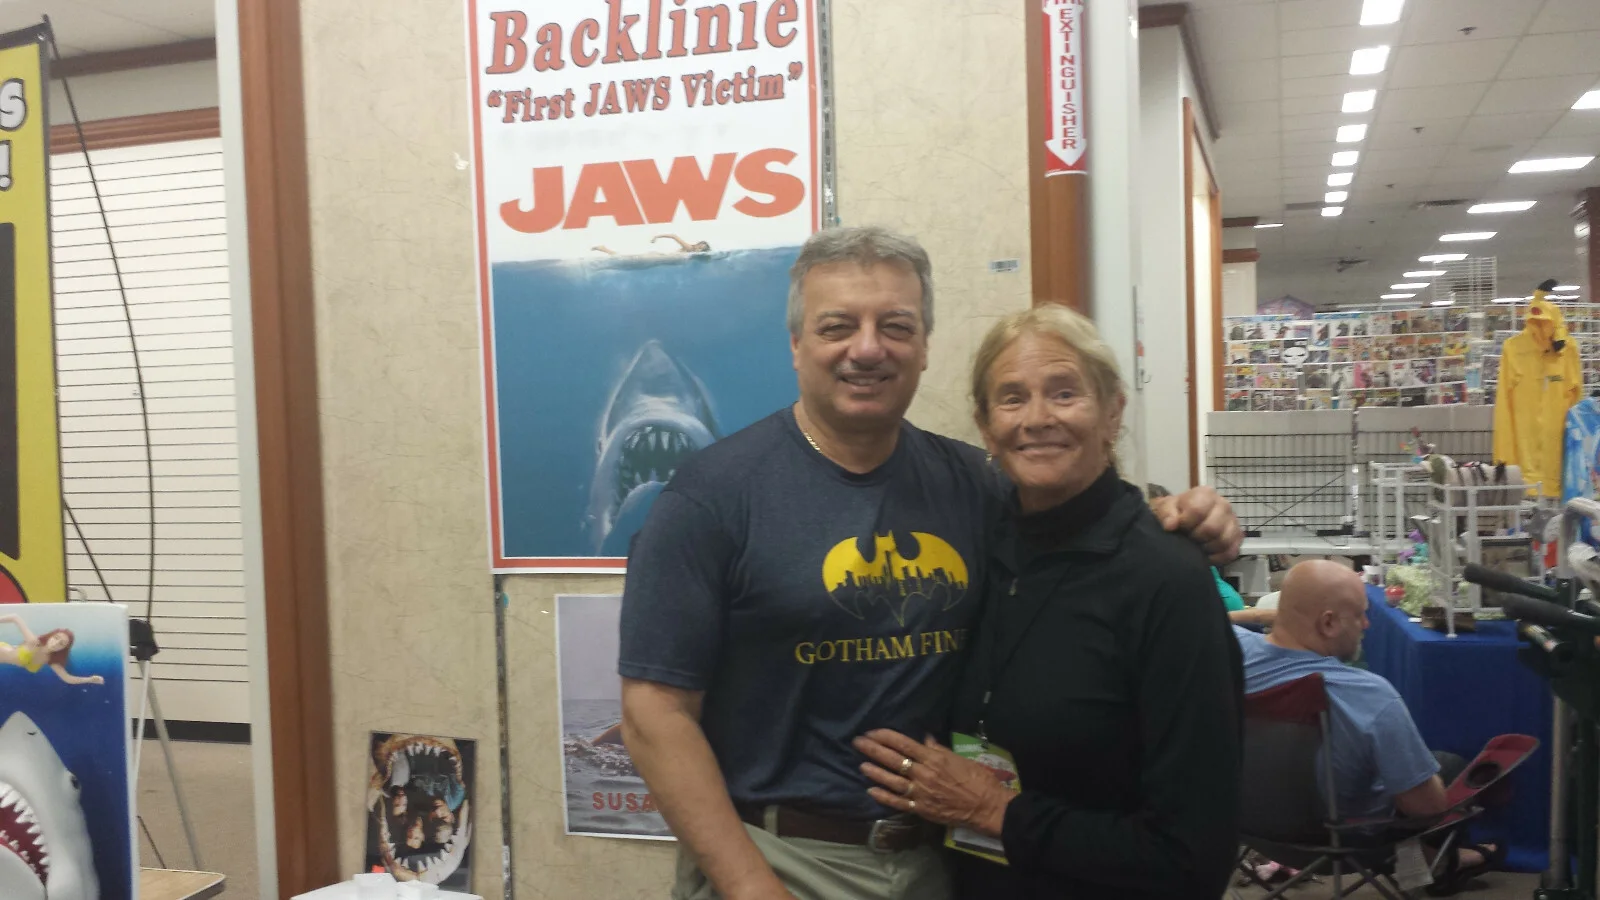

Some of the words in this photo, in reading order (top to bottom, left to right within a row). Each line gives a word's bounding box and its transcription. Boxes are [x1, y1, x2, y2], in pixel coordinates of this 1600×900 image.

[486, 0, 798, 75] Backlinie
[583, 75, 671, 117] JAWS
[1059, 8, 1077, 150] EXTINGUISHER
[499, 147, 806, 234] JAWS
[795, 634, 916, 665] GOTHAM
